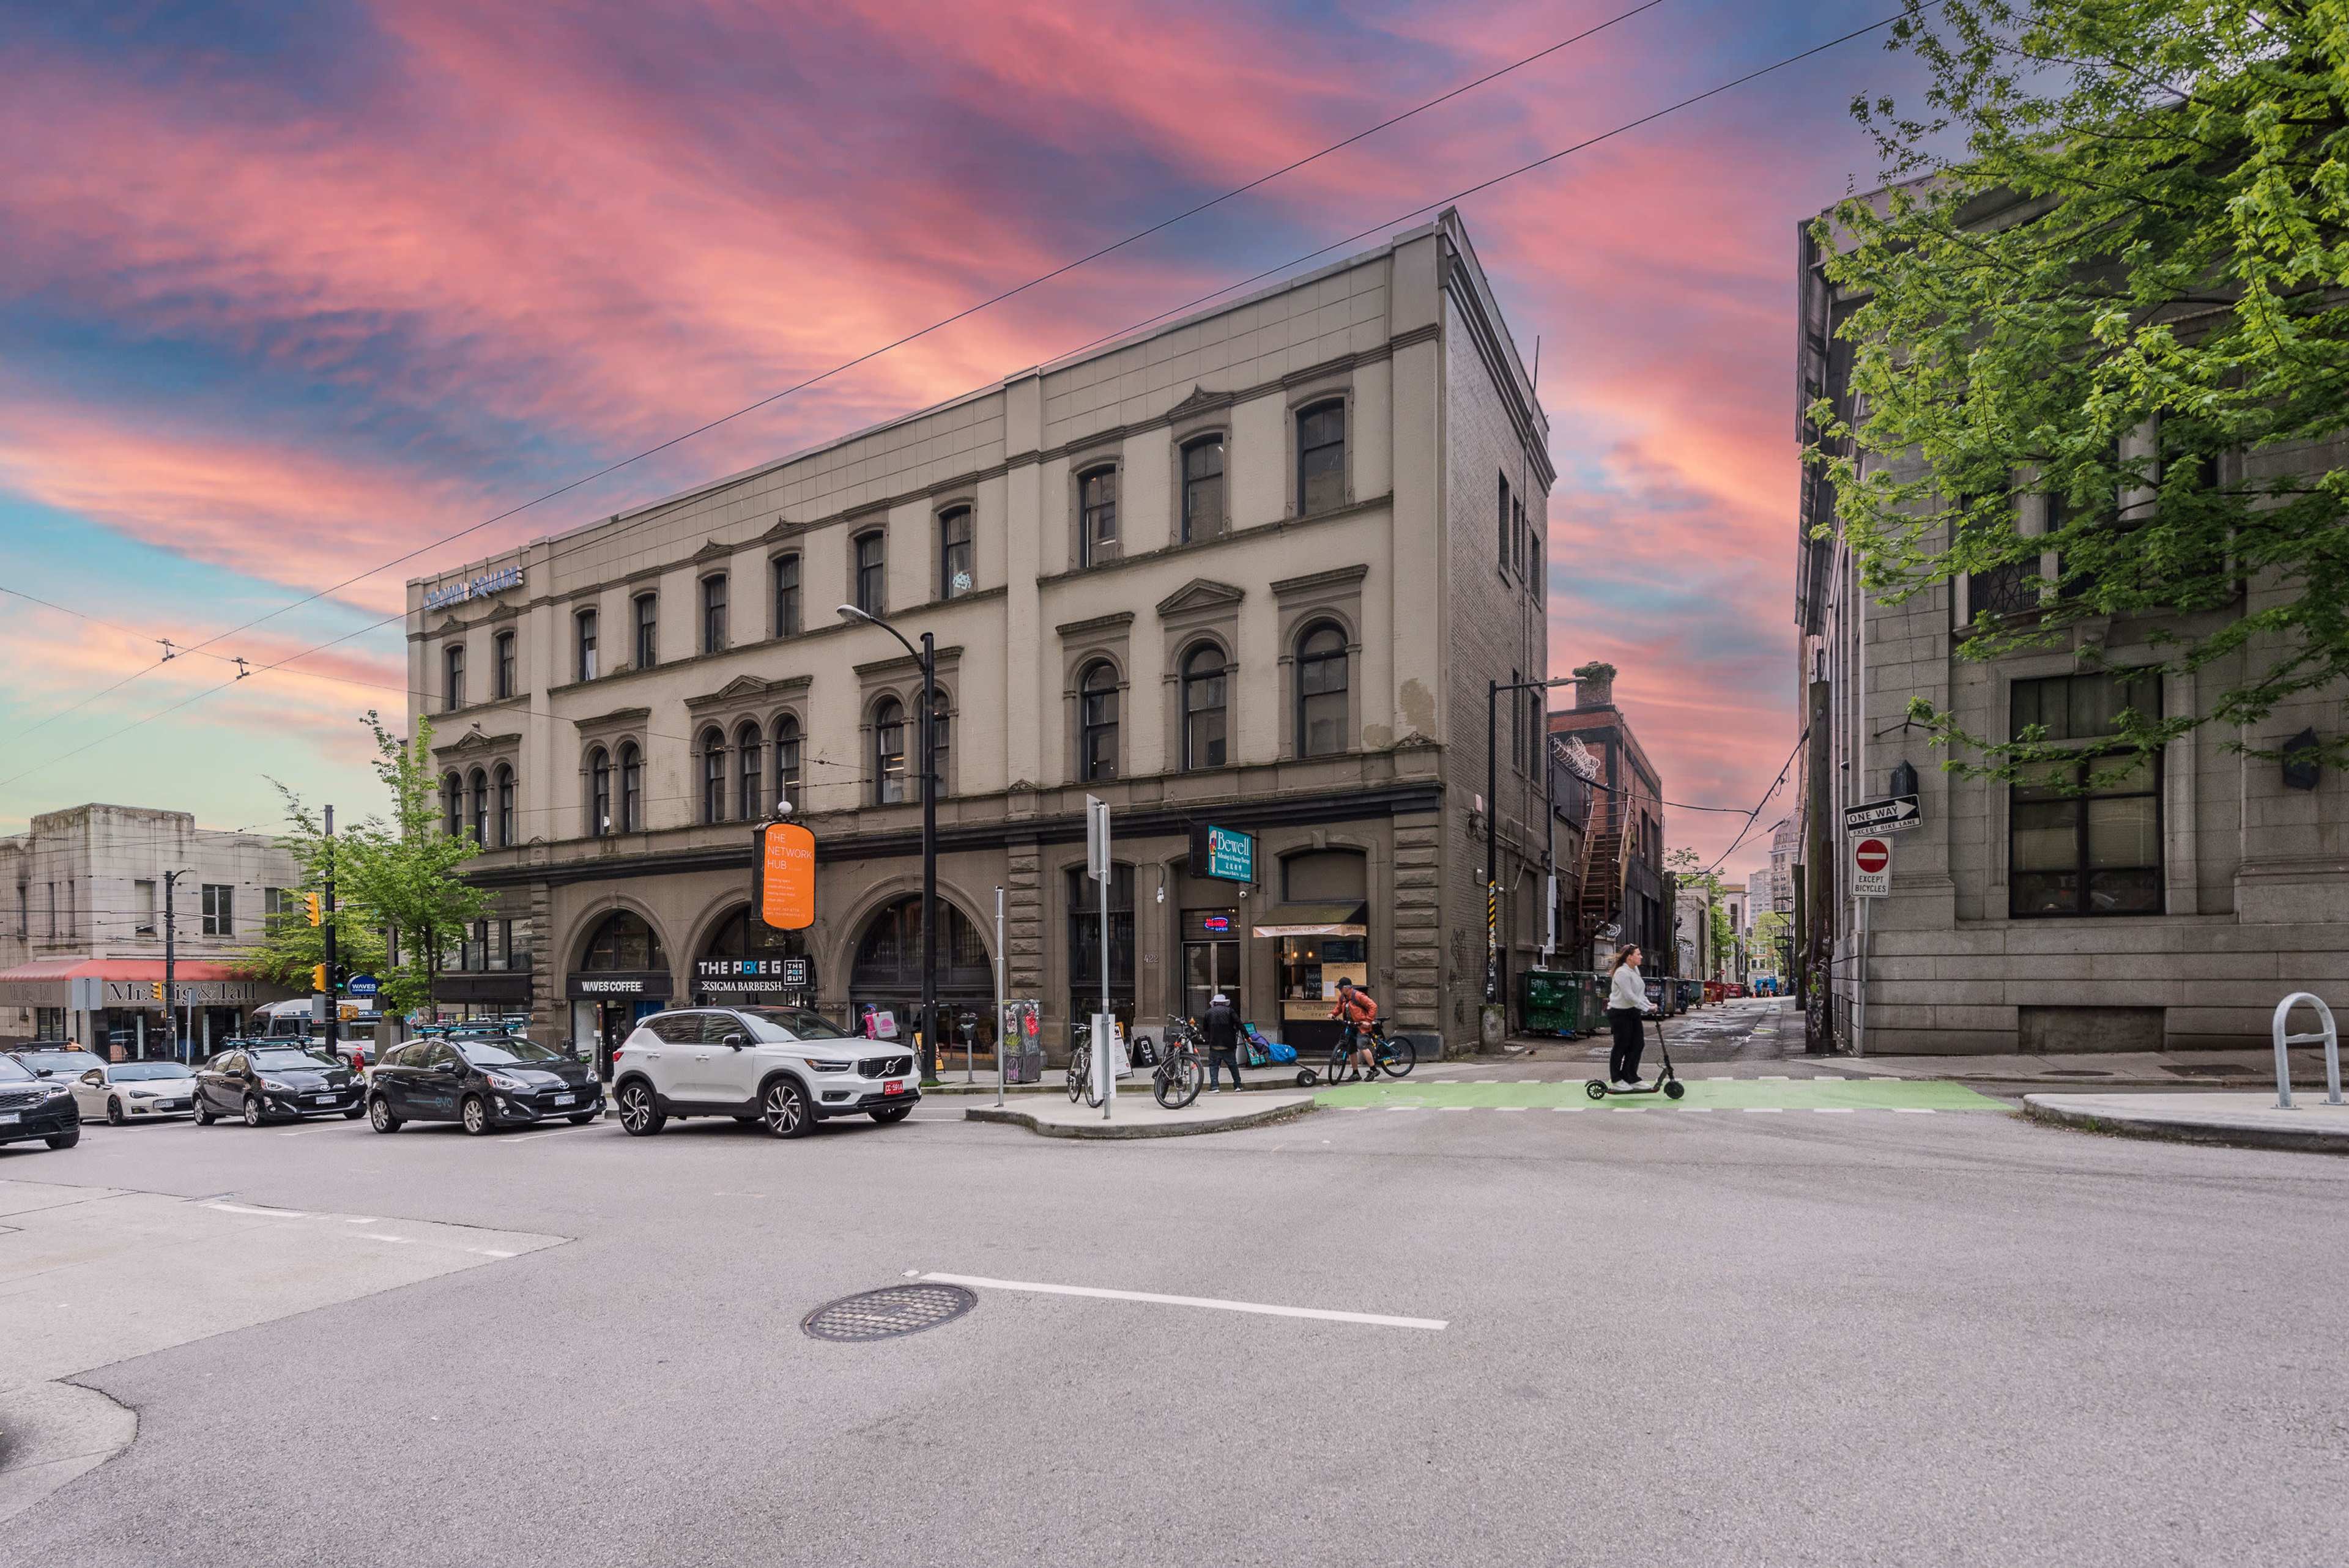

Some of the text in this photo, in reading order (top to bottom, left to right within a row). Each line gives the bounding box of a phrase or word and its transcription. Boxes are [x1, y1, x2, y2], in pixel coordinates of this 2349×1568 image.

[424, 566, 523, 611] CROWN SQUARE
[1850, 806, 1897, 823] ONE WAY
[769, 832, 785, 843] THE
[1217, 832, 1249, 856] Bewell
[768, 845, 812, 859] NETWORK
[767, 858, 787, 870] HUB
[1144, 954, 1159, 963] 422
[699, 961, 728, 974] THE
[733, 961, 766, 974] POKE
[108, 983, 148, 1001] Mr.
[198, 983, 214, 999] &
[215, 983, 256, 1000] Tall
[582, 982, 644, 991] WAVES COFFEE
[710, 981, 792, 991] SIGMA BARBERSH
[435, 1097, 453, 1108] evo
